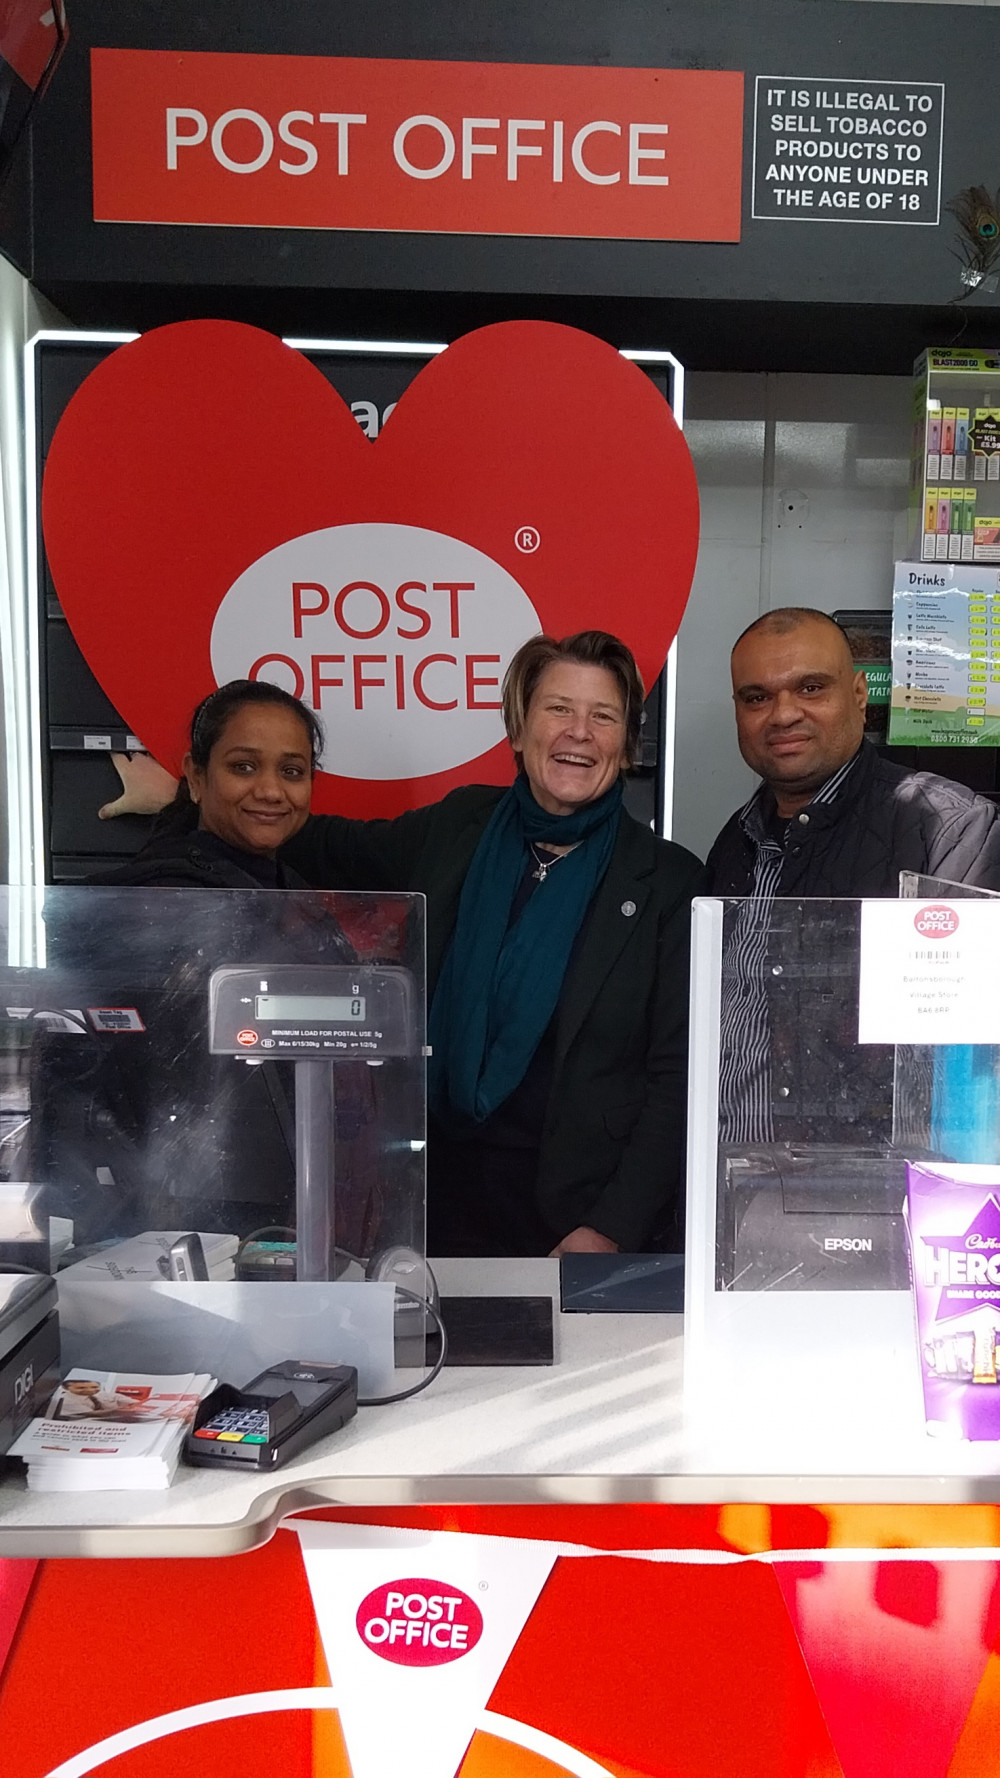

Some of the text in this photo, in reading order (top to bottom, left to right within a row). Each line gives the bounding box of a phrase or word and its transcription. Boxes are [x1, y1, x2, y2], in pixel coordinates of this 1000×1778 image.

[767, 89, 932, 112] IT IS ILLEGAL TO
[771, 114, 927, 136] SELL TOBACCO
[166, 108, 669, 186] POST OFFICE
[775, 140, 921, 161] PRODUCTS TO
[765, 164, 928, 186] ANYONE UNDER
[773, 189, 920, 210] THE AGE OF 18
[909, 572, 945, 586] Drinks
[292, 581, 475, 639] POST
[248, 653, 502, 711] OFFICE
[917, 921, 954, 931] OFFICE
[924, 911, 951, 920] POST
[352, 985, 359, 994] g
[351, 1000, 360, 1016] 0
[824, 1238, 872, 1251] EPSON
[14, 1363, 34, 1405] DIGI
[41, 1423, 102, 1431] Prohibited
[385, 1591, 462, 1622] POST
[364, 1617, 469, 1649] OFFICE
